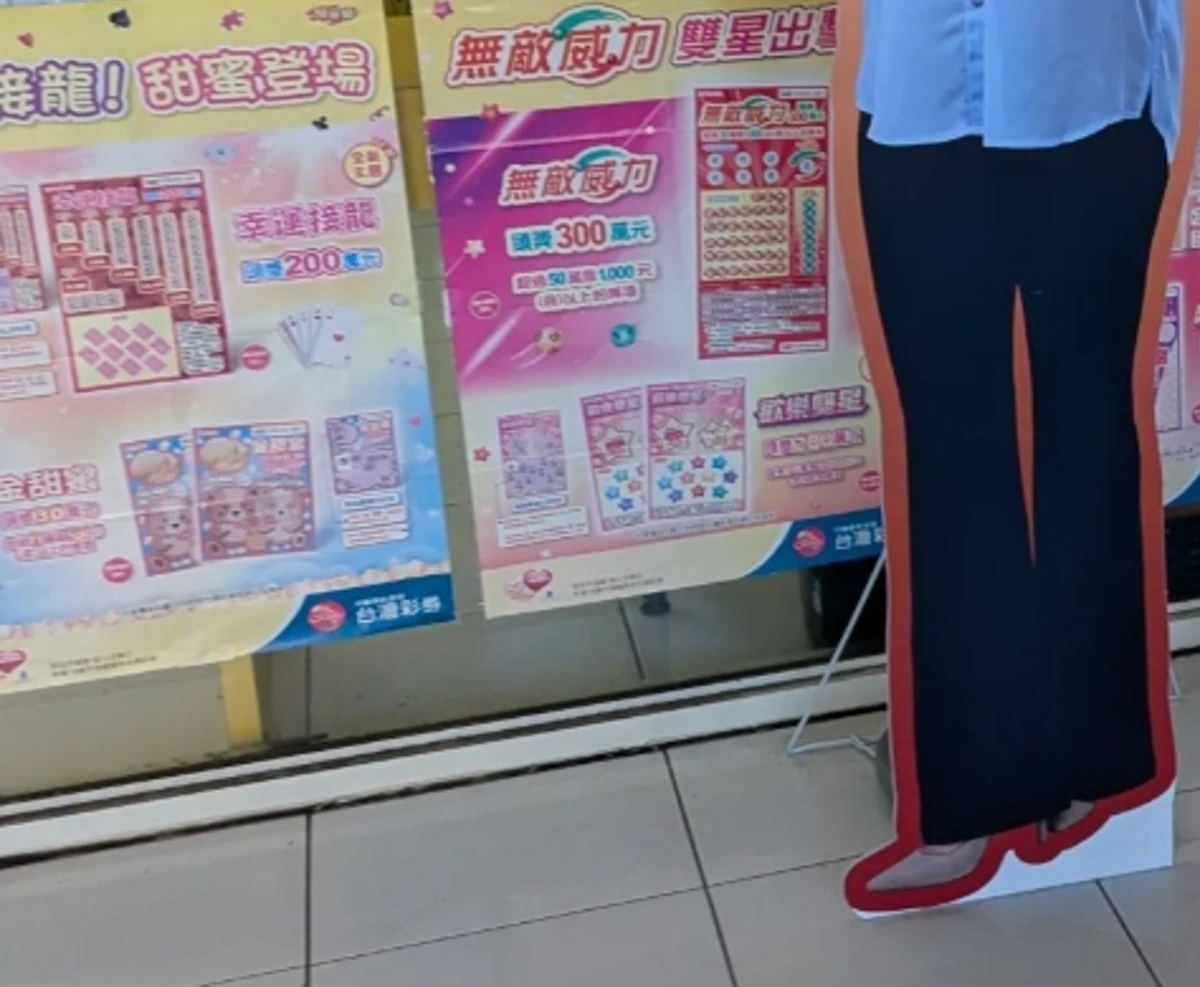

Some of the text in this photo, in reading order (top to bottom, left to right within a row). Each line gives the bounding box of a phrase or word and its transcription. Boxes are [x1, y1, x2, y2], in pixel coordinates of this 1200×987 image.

[453, 17, 662, 80] 無敵威力
[141, 45, 370, 110] 甜蜜登場
[503, 155, 653, 202] 無敵威力
[236, 198, 377, 239] 幸運接龍
